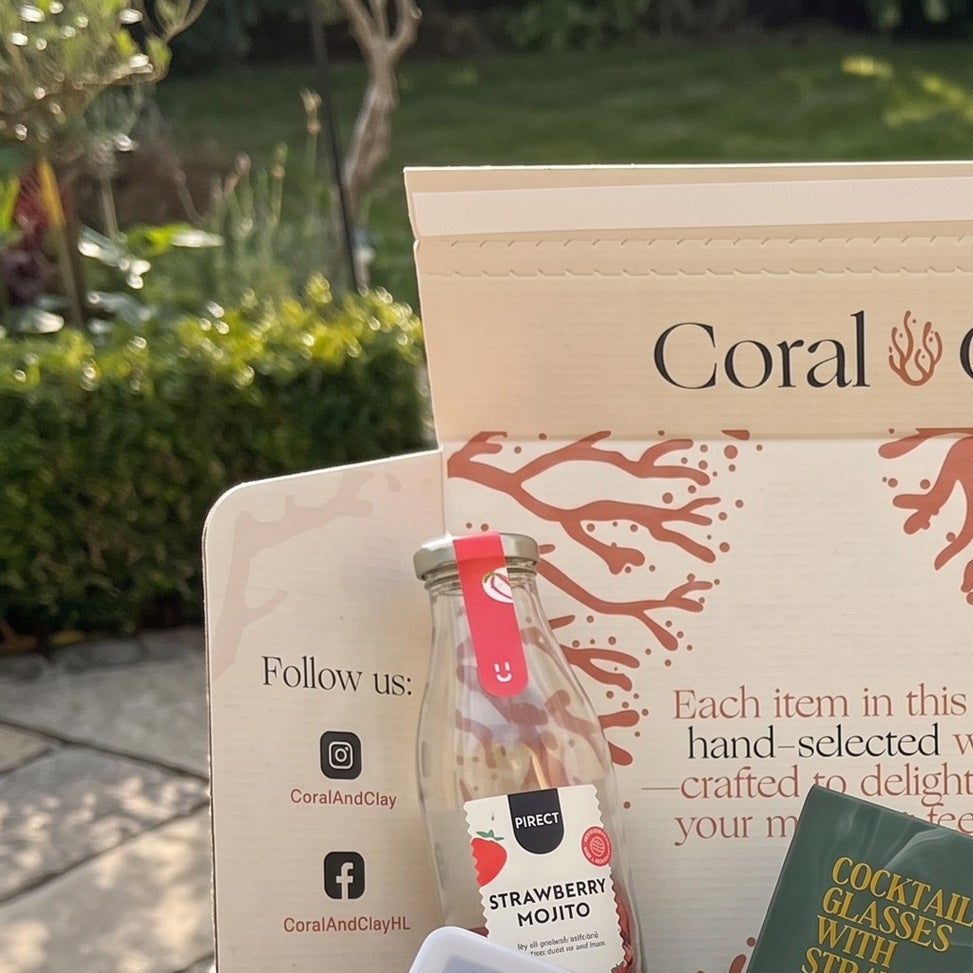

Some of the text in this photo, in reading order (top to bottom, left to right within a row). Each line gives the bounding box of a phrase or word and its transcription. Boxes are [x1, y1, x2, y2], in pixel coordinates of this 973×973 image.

[653, 310, 871, 390] Coral
[262, 656, 412, 696] Follow us:
[673, 685, 761, 719] Each
[774, 688, 849, 718] item
[862, 687, 894, 717] in
[906, 682, 967, 716] this
[290, 788, 397, 809] CoralAndClay
[515, 812, 559, 829] PIRECT
[674, 816, 753, 846] your
[489, 878, 606, 910] STRAWBERRY
[284, 916, 411, 934] CoralAndClayHL
[517, 902, 590, 927] MOJITO
[822, 886, 953, 952] GLASSES
[817, 914, 898, 968] WITH
